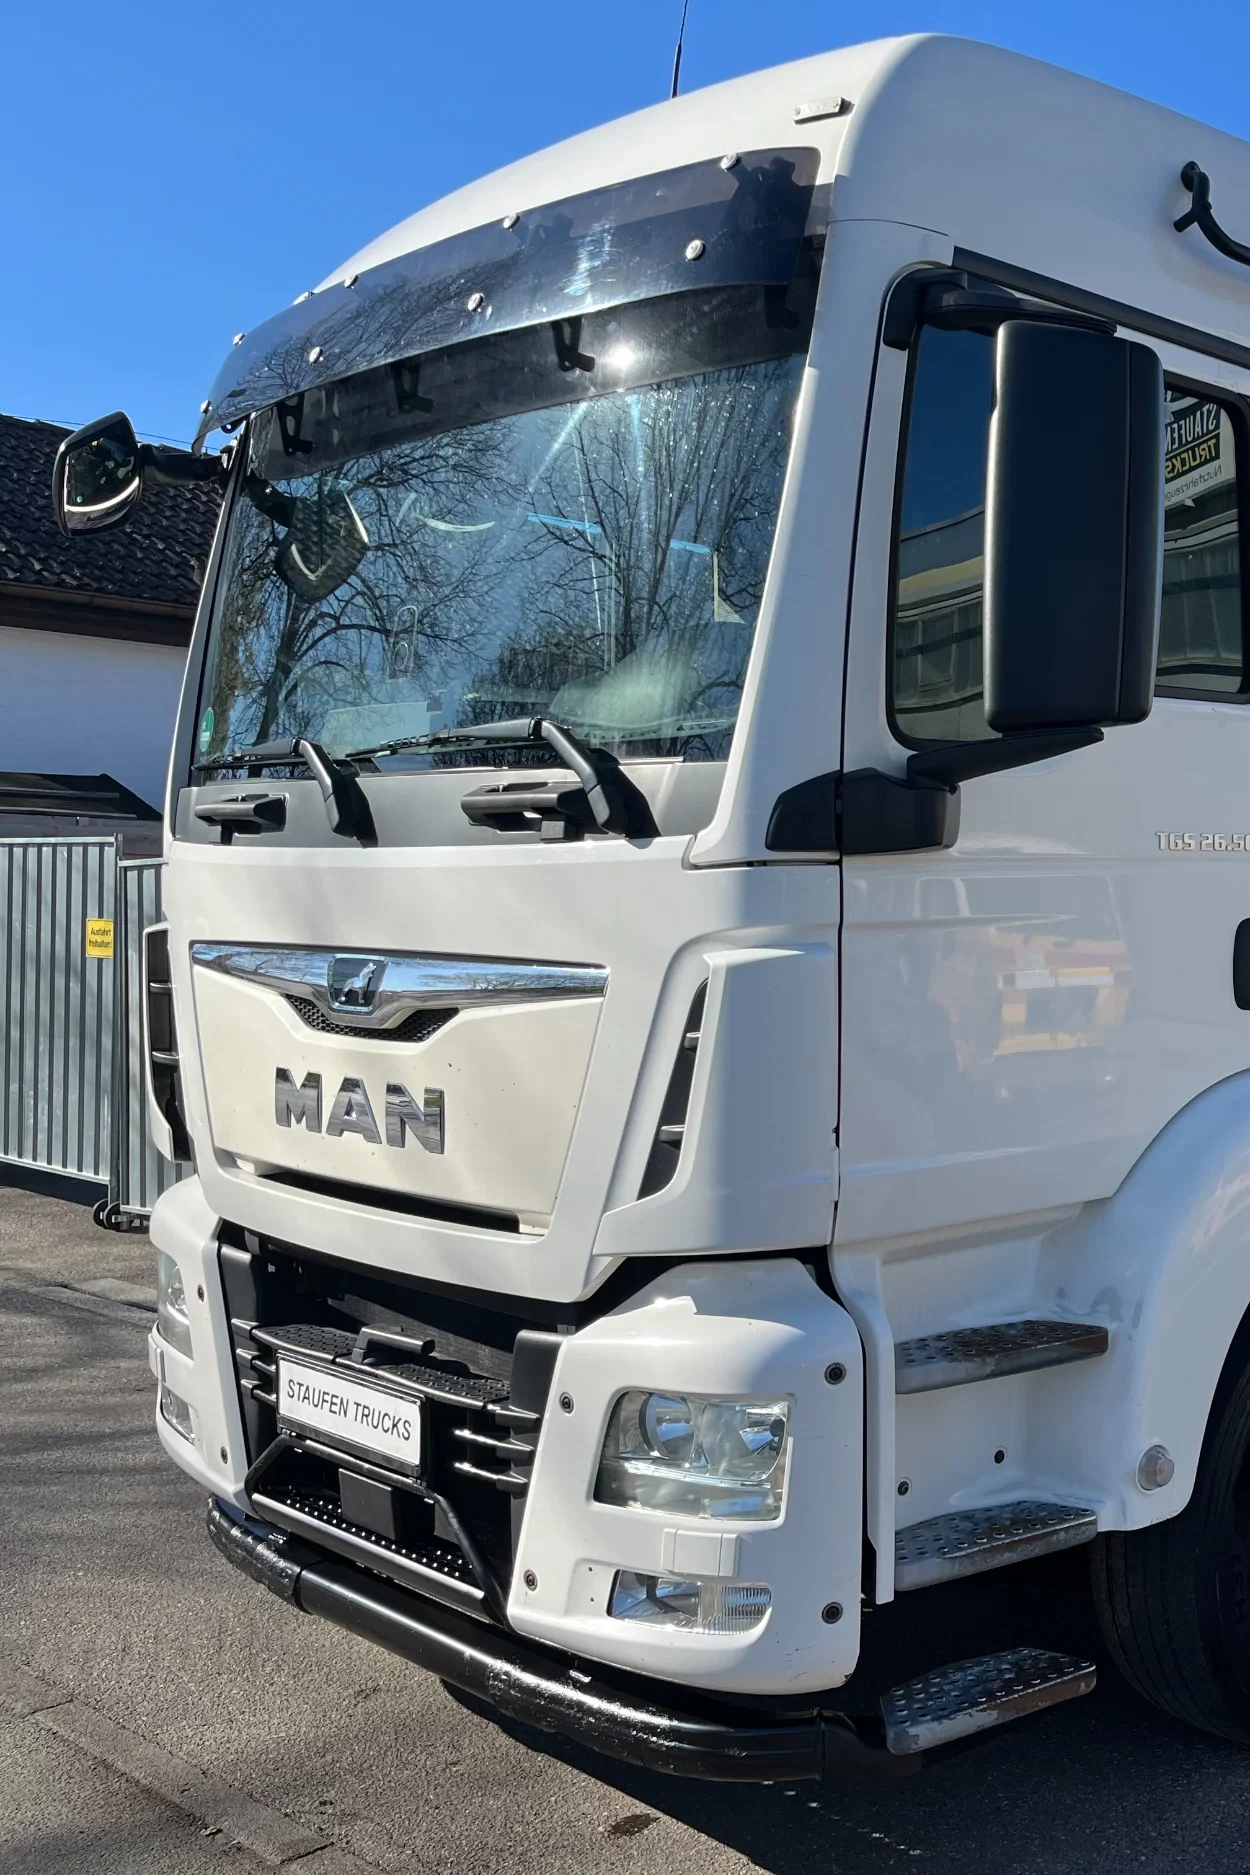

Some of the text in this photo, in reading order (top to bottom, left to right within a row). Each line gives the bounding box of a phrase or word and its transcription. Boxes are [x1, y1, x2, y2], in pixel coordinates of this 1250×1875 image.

[1155, 831, 1196, 851] TGS
[275, 1066, 446, 1155] MAN
[287, 1378, 412, 1442] STAUFEN TRUCKS
